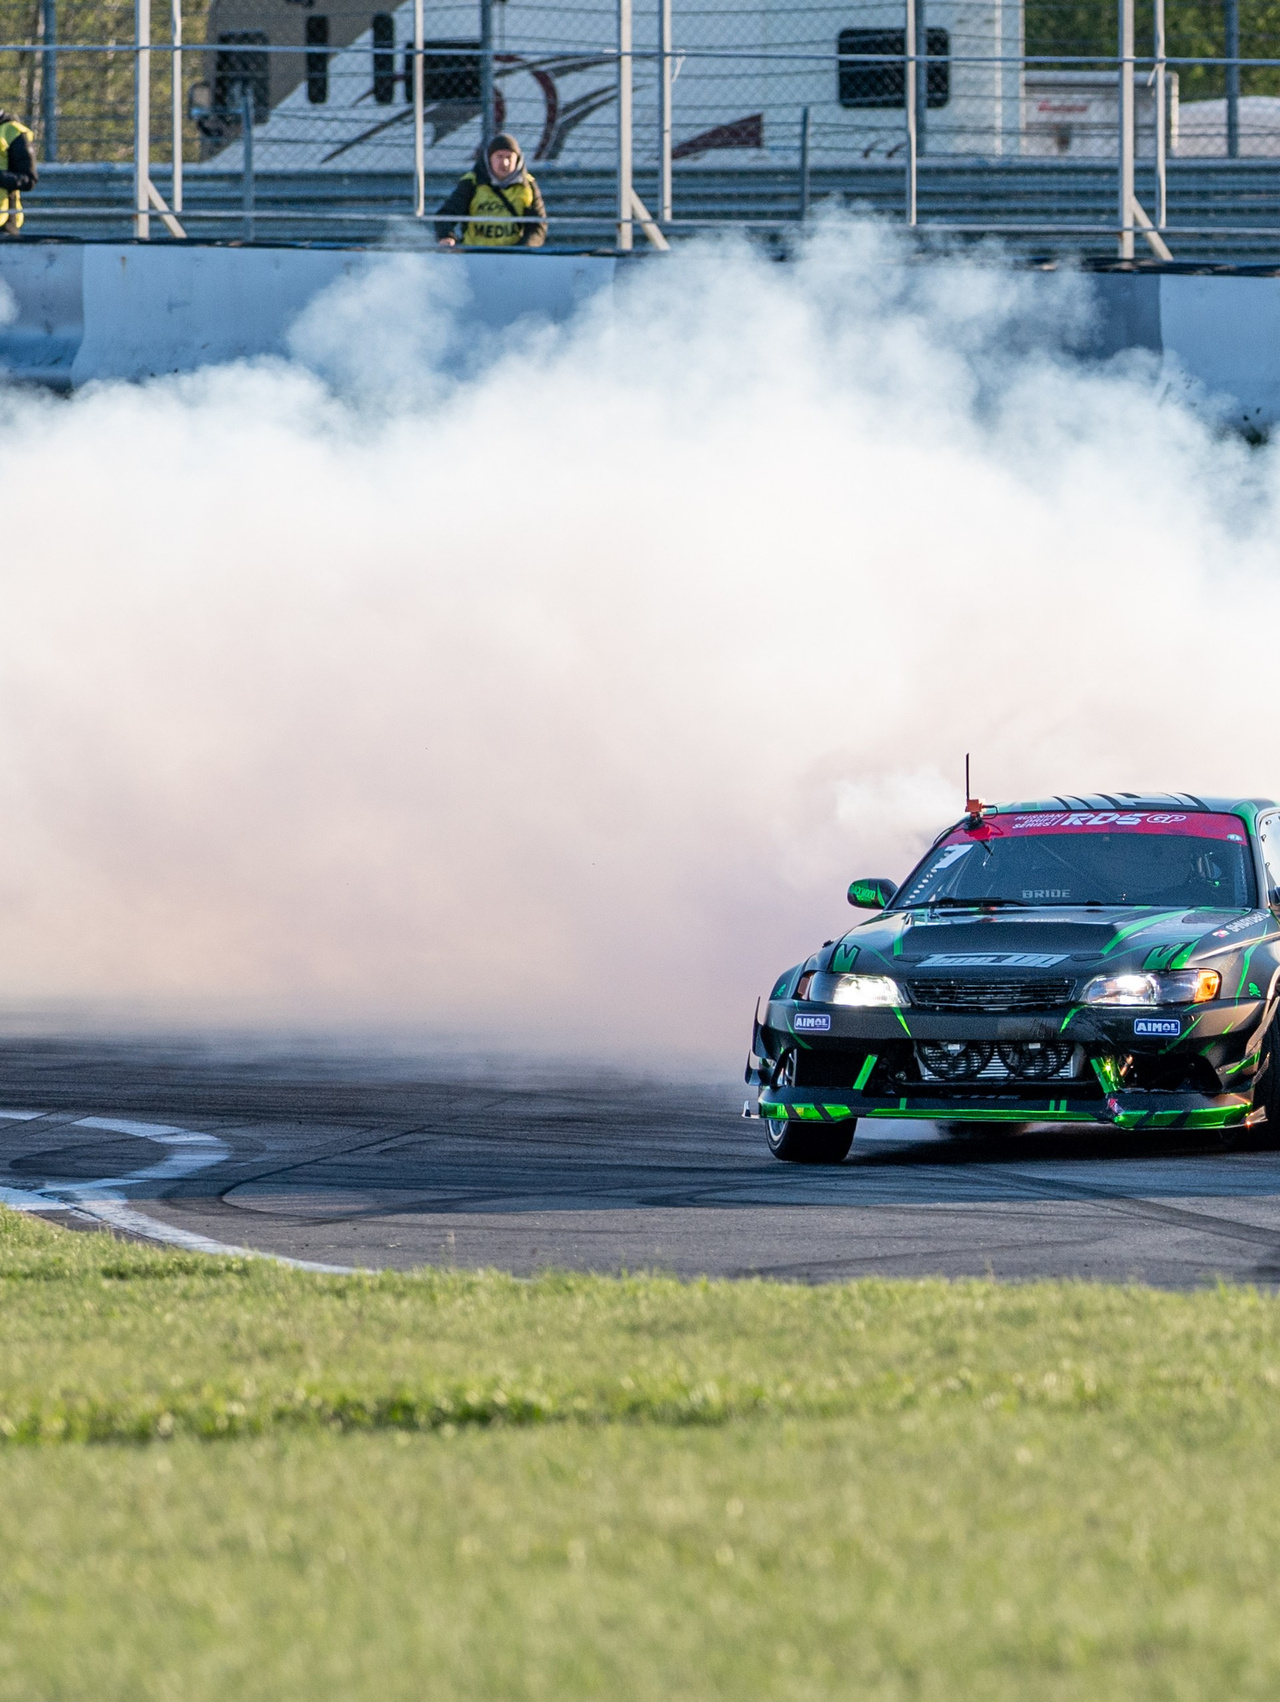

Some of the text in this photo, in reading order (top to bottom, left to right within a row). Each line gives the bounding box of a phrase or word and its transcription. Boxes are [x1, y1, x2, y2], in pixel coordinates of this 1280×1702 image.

[1014, 813, 1063, 822] RUSSIAN
[1060, 813, 1187, 826] RDS GP
[1013, 821, 1052, 829] SERIES
[1021, 889, 1071, 899] BRIDE
[795, 1017, 829, 1029] AIMOL
[1136, 1020, 1178, 1033] AIMOL
